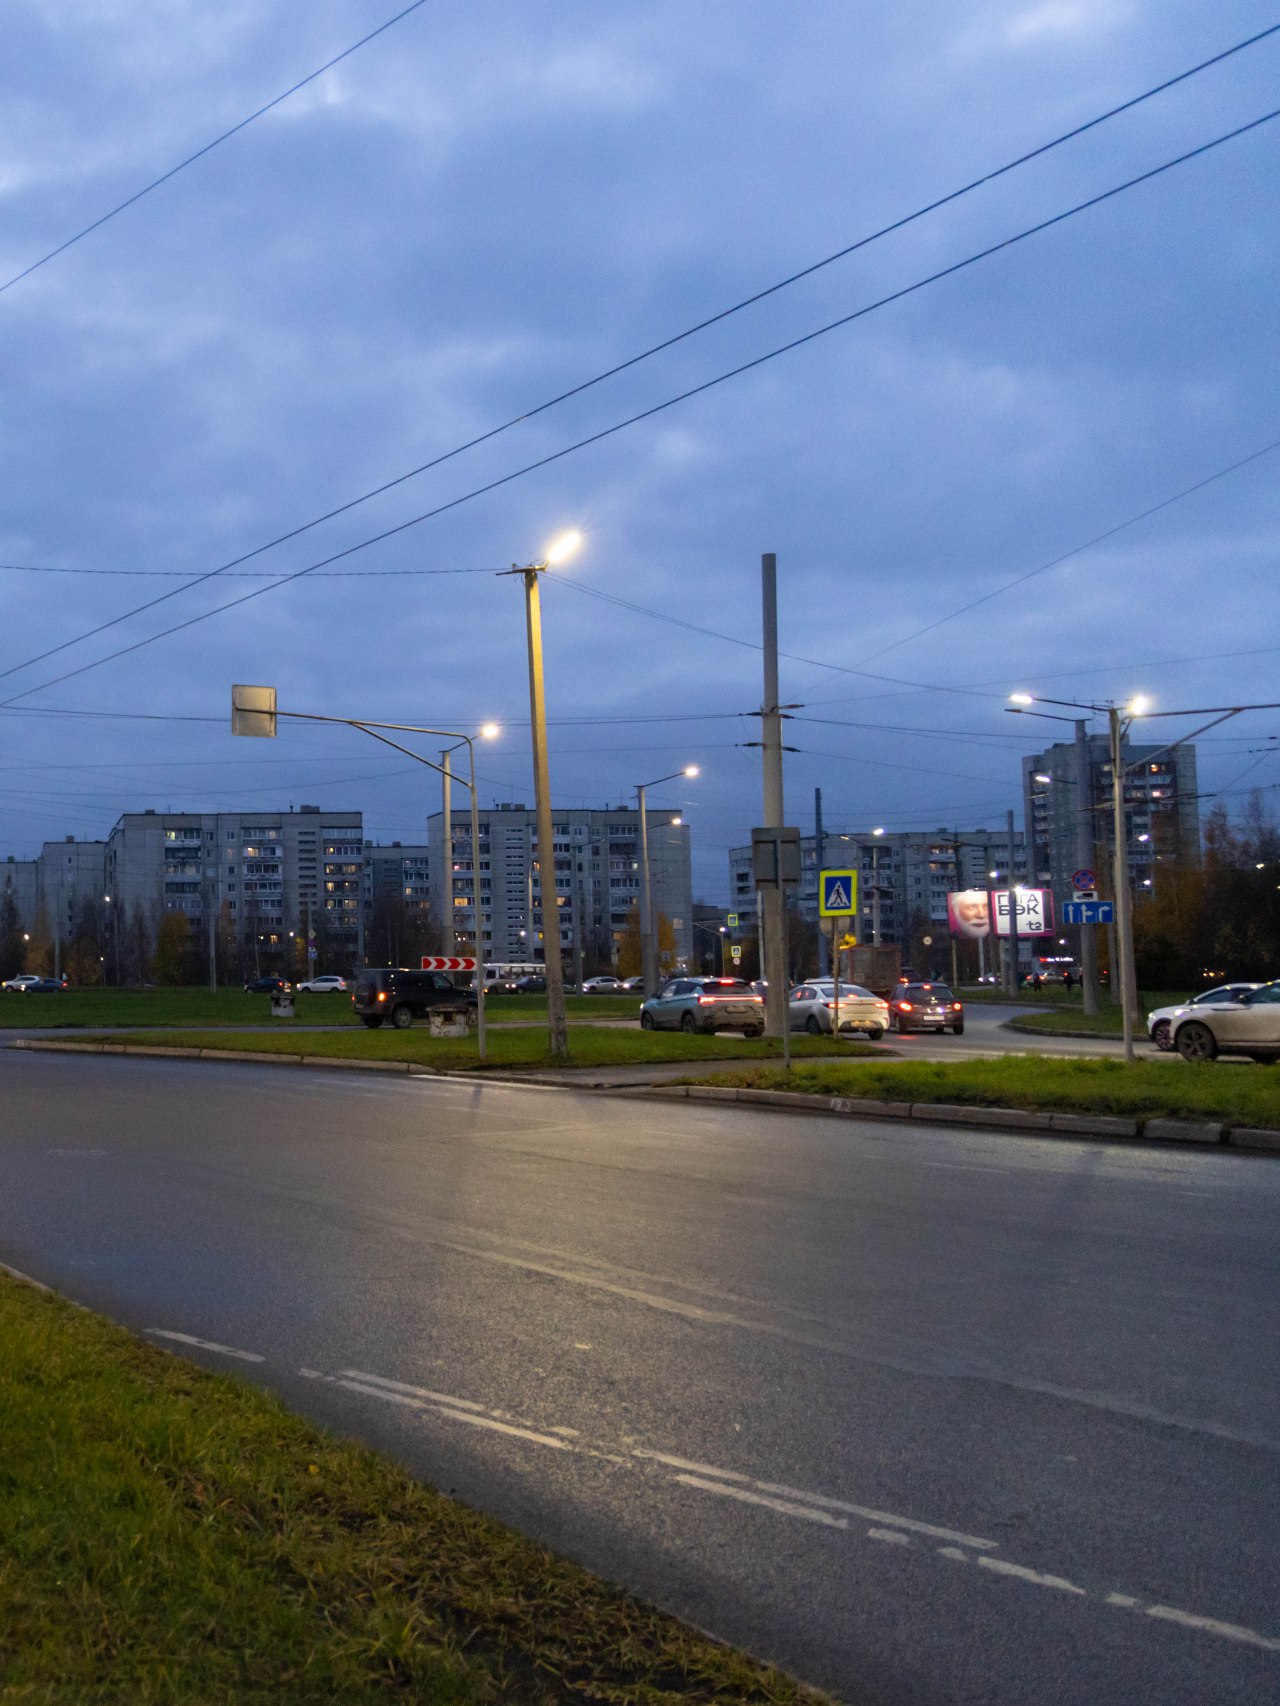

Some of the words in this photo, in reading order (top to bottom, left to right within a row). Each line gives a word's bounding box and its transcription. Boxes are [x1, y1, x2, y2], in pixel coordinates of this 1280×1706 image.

[997, 894, 1039, 904] ГГА
[998, 904, 1040, 916] БЭК
[1026, 920, 1042, 931] t2
